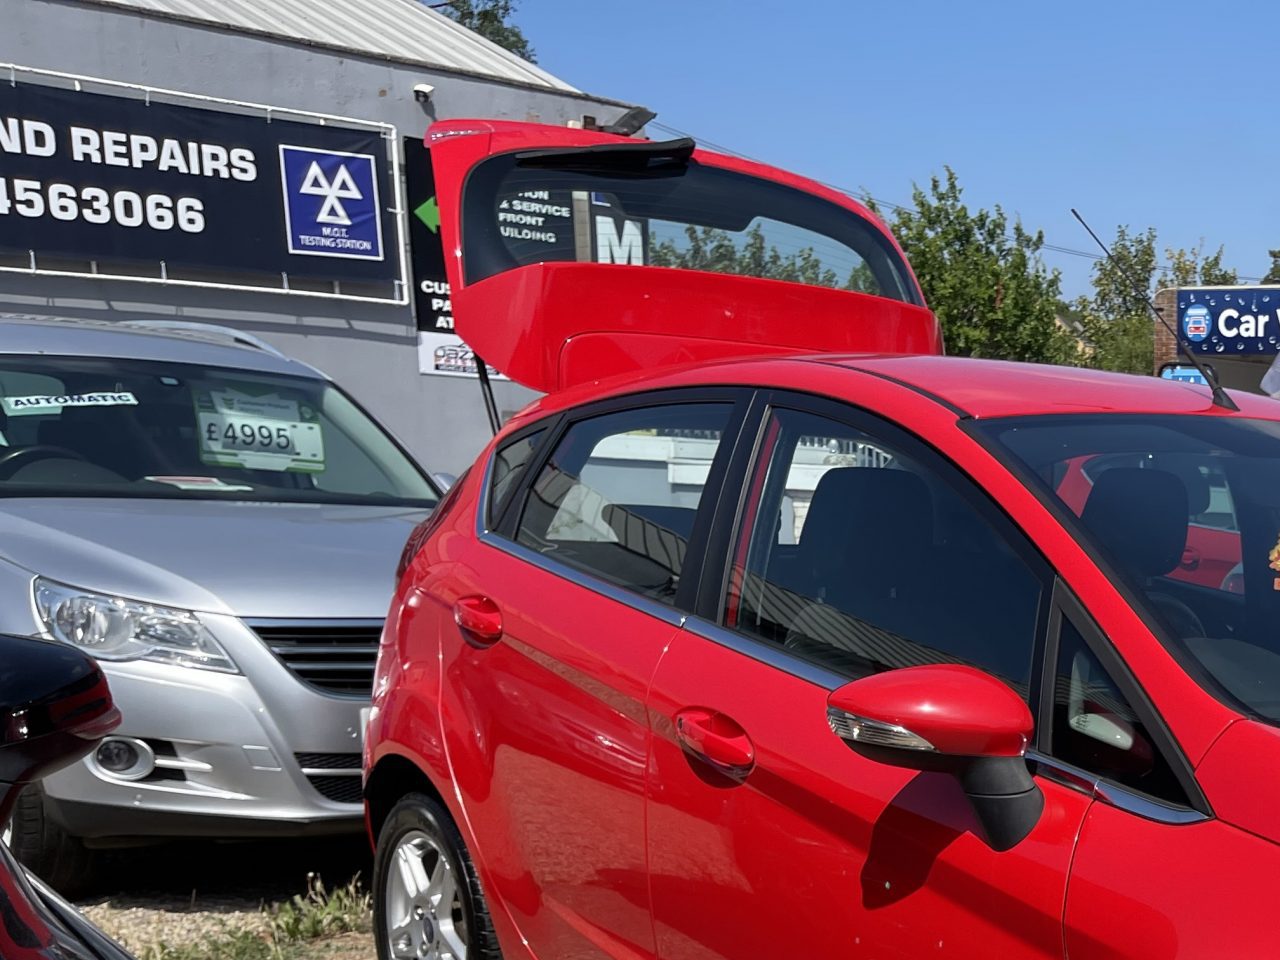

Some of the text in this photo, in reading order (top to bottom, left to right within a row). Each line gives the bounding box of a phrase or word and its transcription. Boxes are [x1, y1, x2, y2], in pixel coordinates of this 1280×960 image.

[0, 118, 258, 182] ND REPAIRS
[512, 199, 571, 217] SERVICE
[499, 212, 545, 226] FRONT
[299, 235, 372, 250] TESTING STATION
[500, 226, 556, 243] UILDING
[595, 215, 645, 266] M
[1217, 308, 1270, 338] Car
[14, 394, 132, 407] AUTOMATIC
[206, 422, 290, 449] £4995
